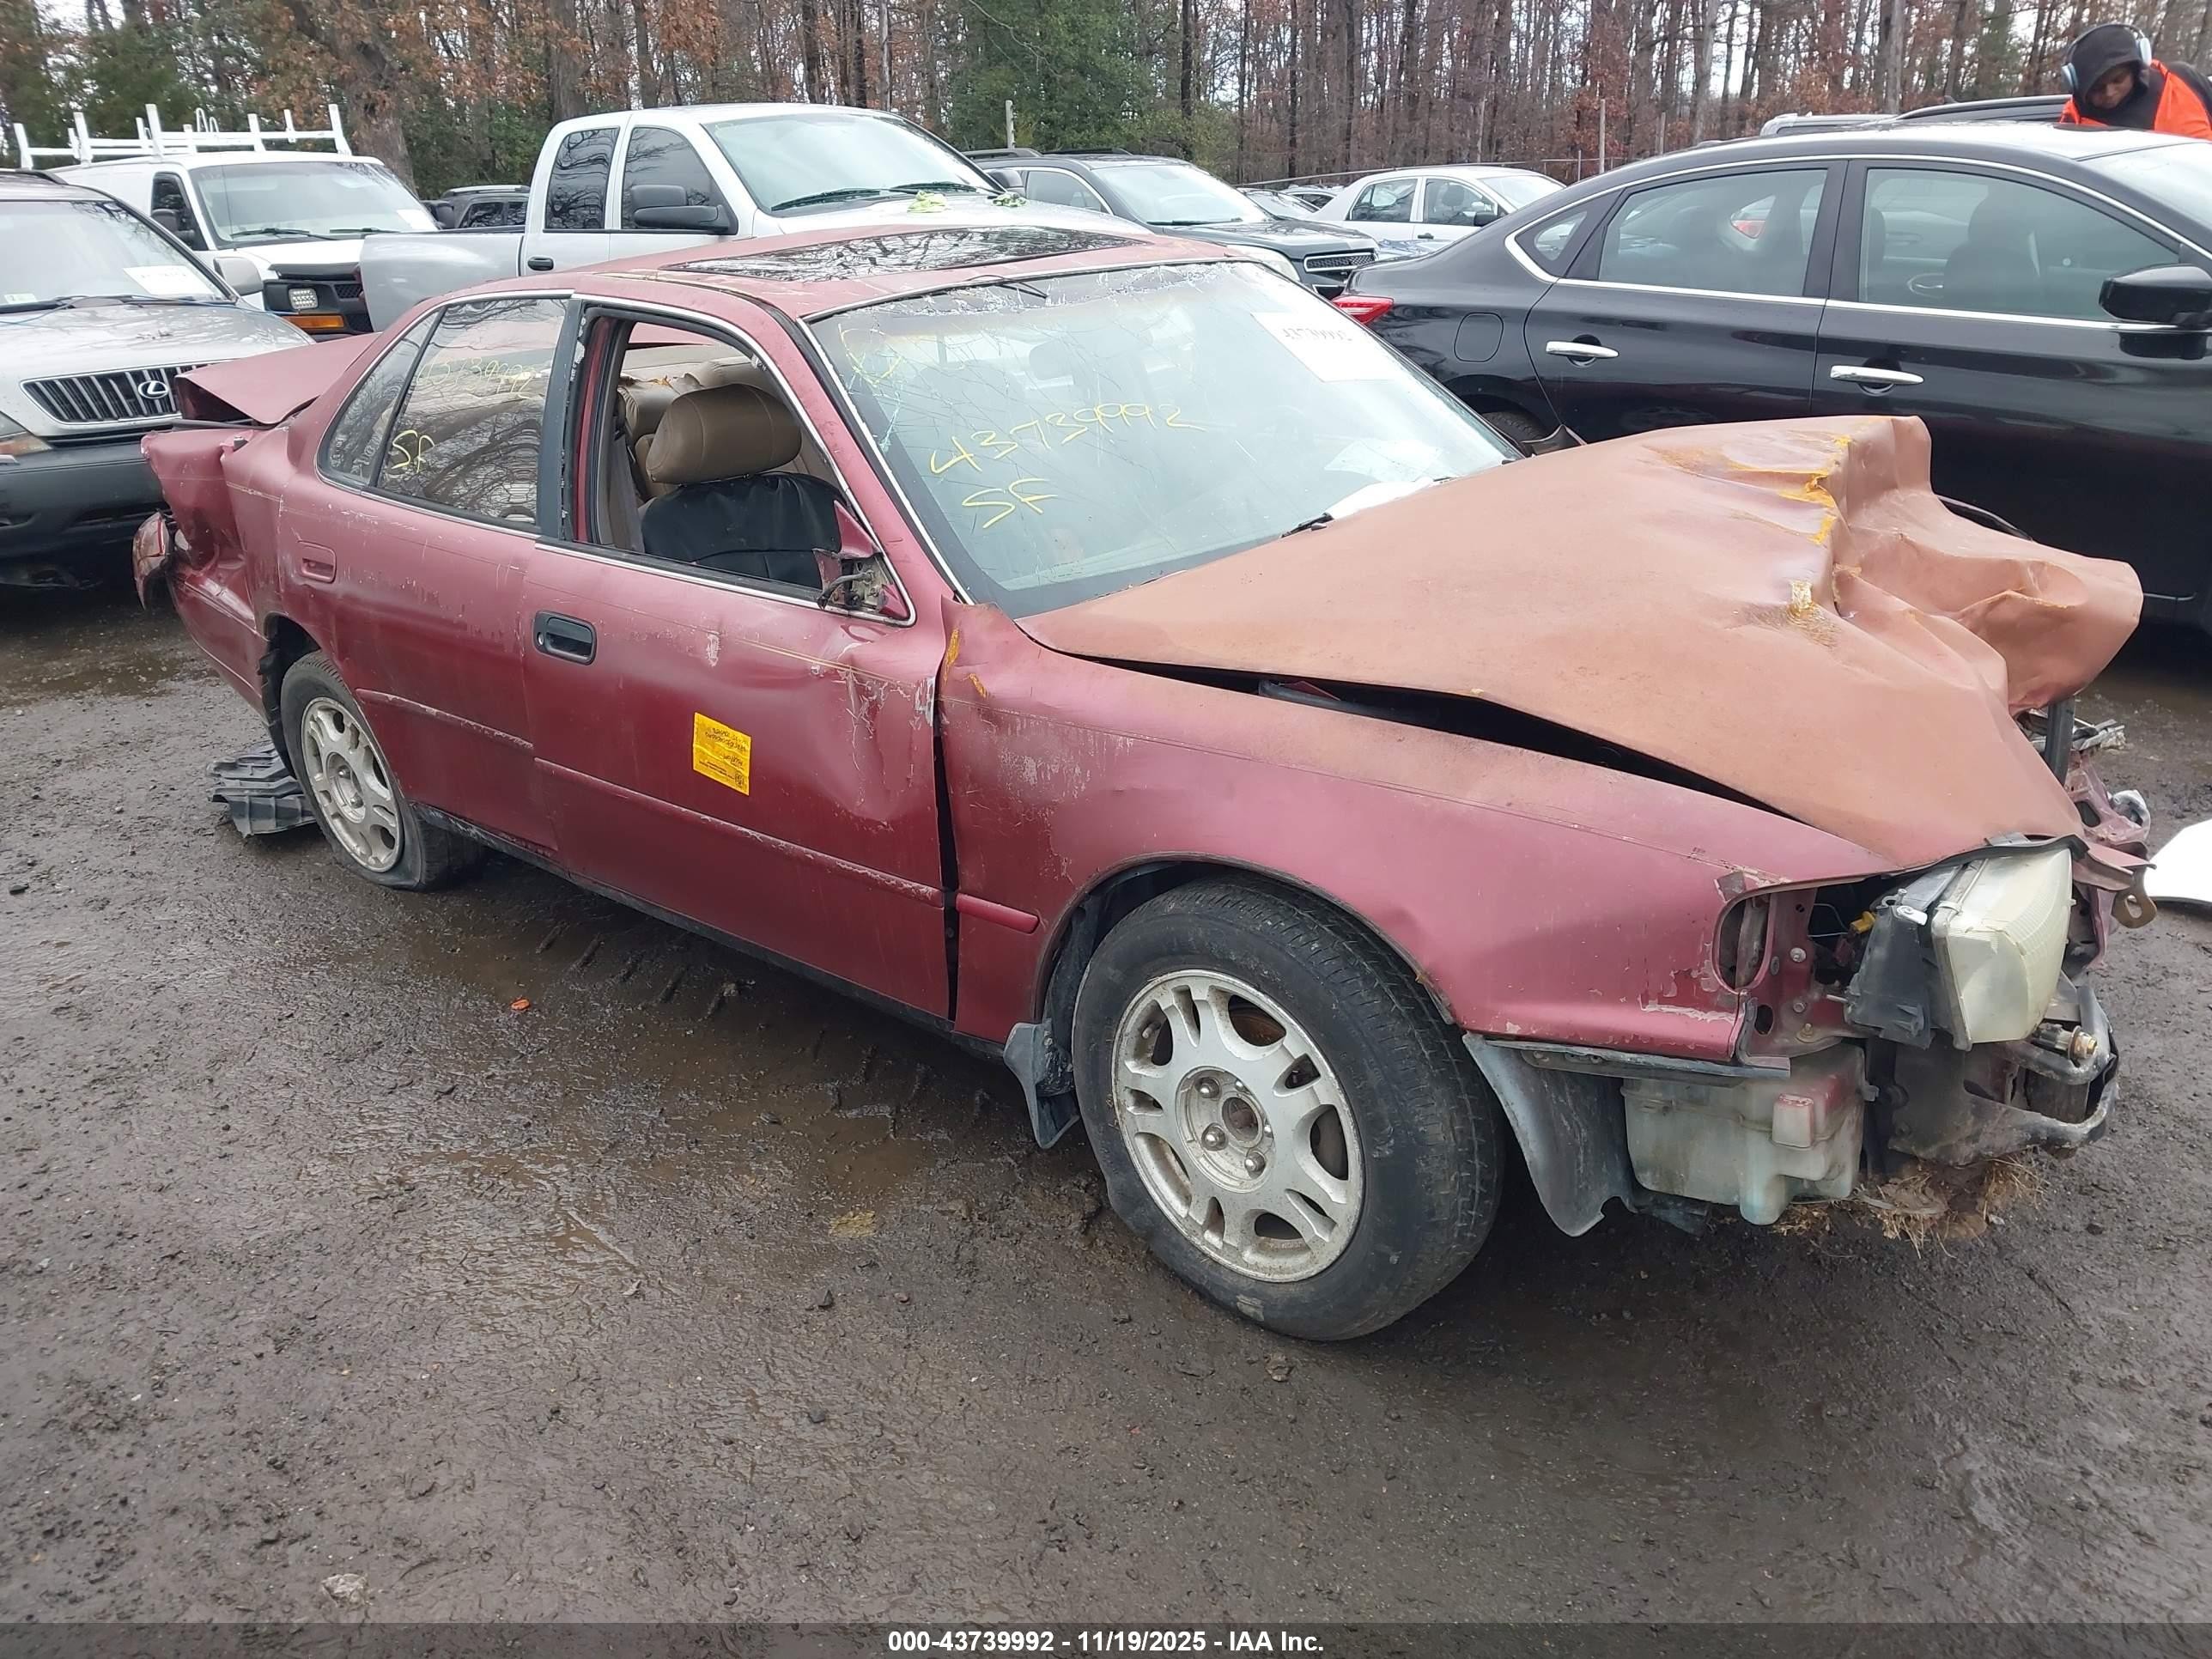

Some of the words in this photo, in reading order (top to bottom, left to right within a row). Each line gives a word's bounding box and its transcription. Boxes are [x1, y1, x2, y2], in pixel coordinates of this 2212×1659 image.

[392, 429, 435, 474] SF
[929, 403, 1207, 474] 43739992
[962, 477, 1059, 528] SF
